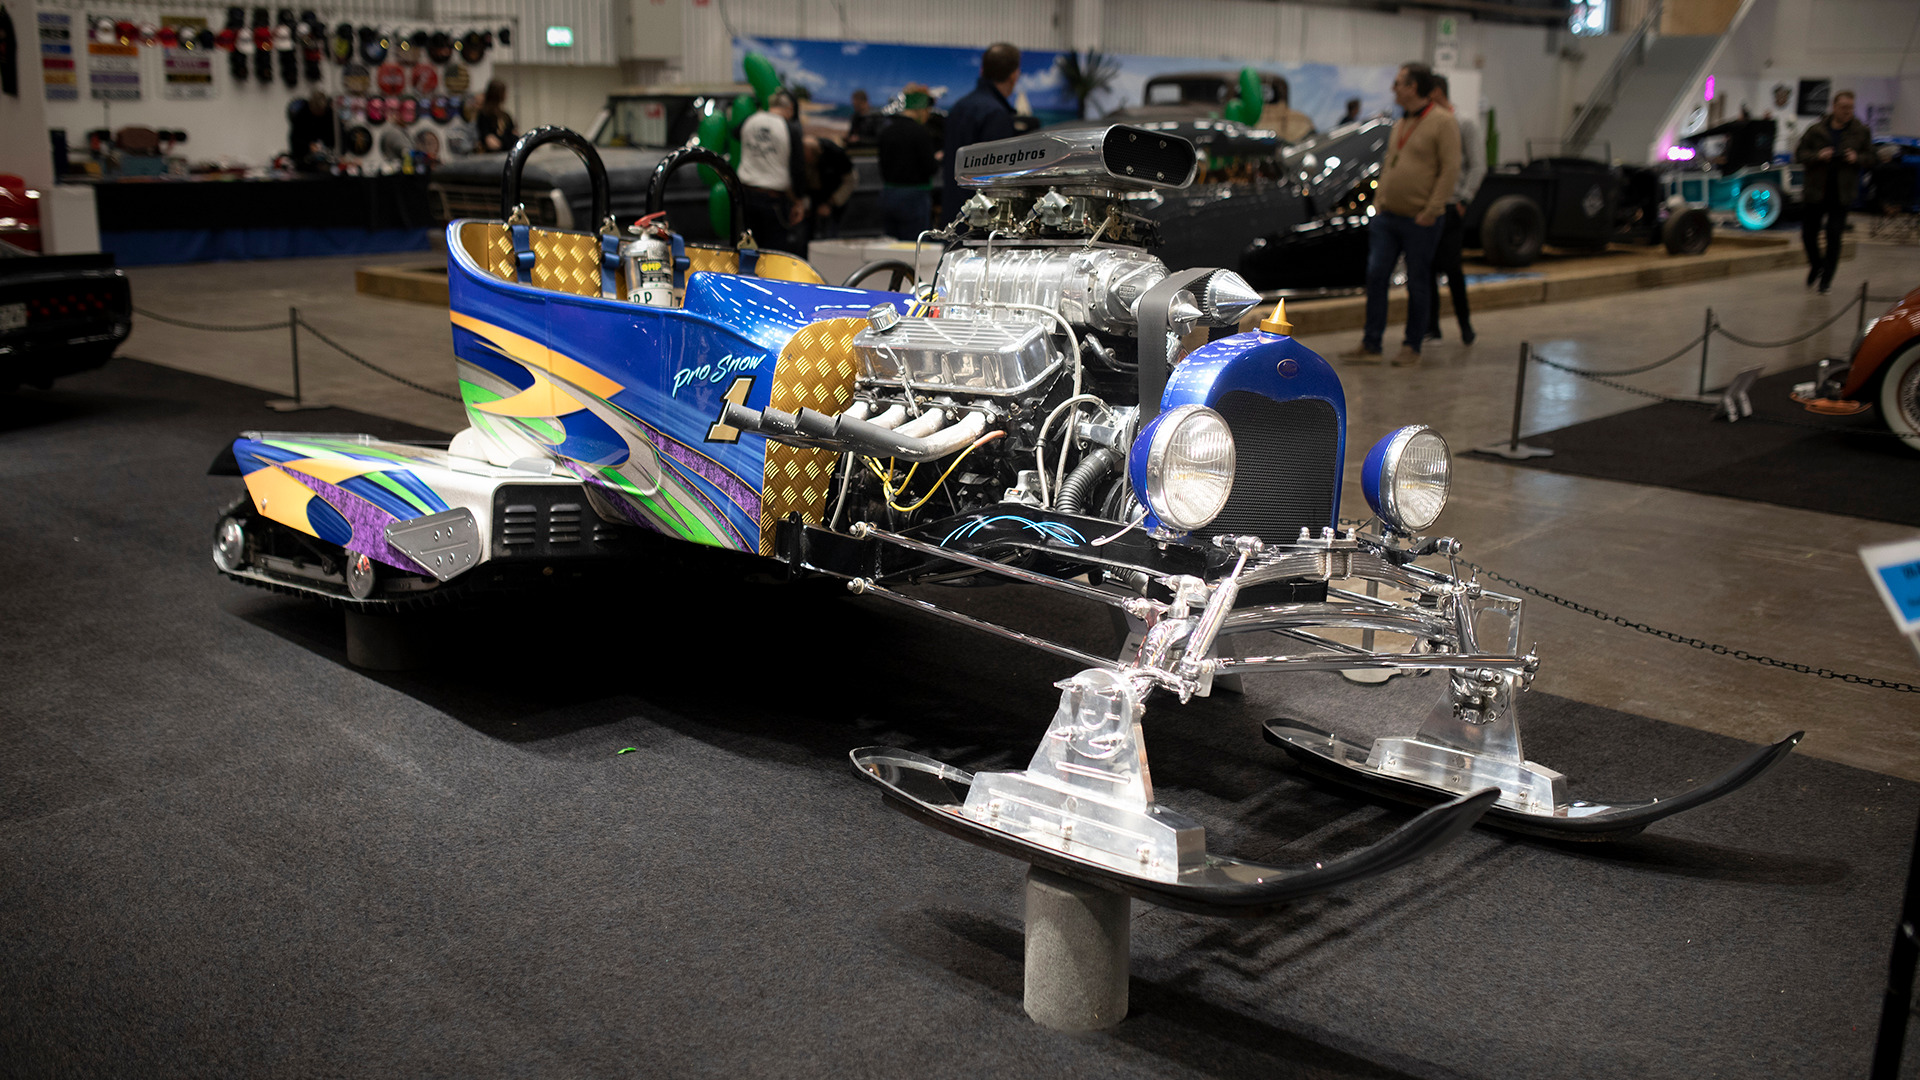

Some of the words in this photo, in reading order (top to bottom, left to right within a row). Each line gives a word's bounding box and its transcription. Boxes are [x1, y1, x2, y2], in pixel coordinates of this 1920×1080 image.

[963, 149, 1046, 168] Lindbergbros
[641, 262, 662, 272] OMP
[710, 353, 767, 383] Snow
[704, 376, 756, 444] 1
